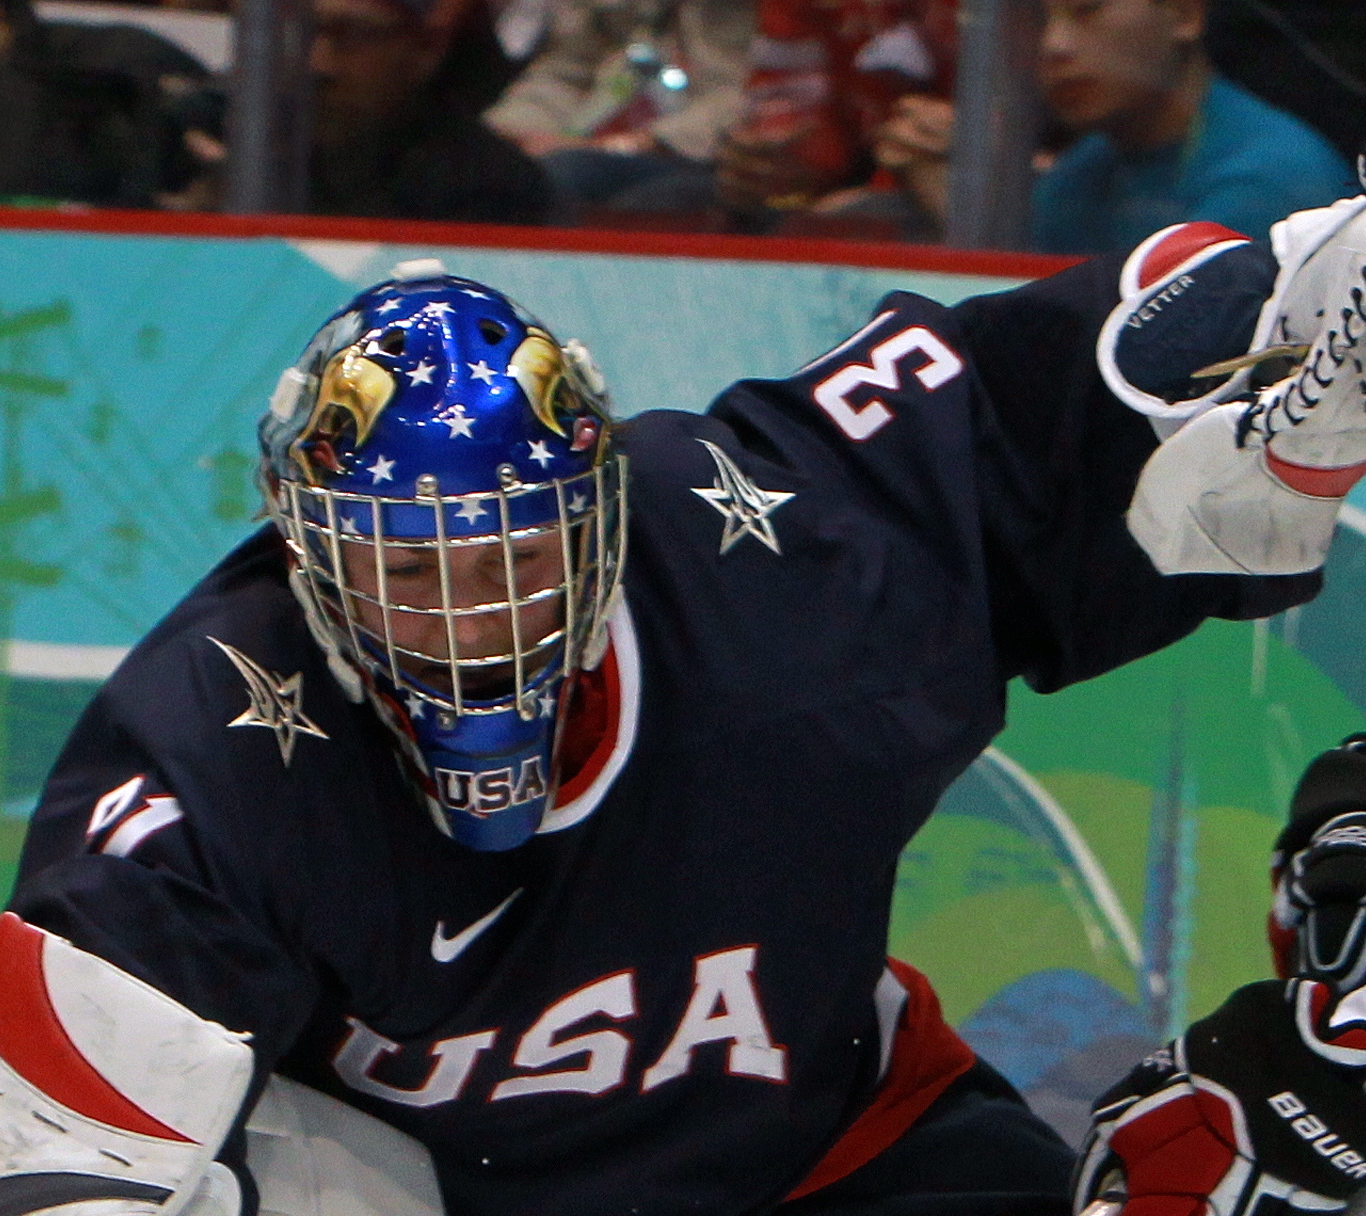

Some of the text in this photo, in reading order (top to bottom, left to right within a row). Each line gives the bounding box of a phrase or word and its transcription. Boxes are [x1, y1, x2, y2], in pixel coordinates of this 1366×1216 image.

[1126, 275, 1195, 329] VETTER
[795, 308, 966, 443] 3
[434, 754, 547, 813] USA
[330, 941, 790, 1109] USA
